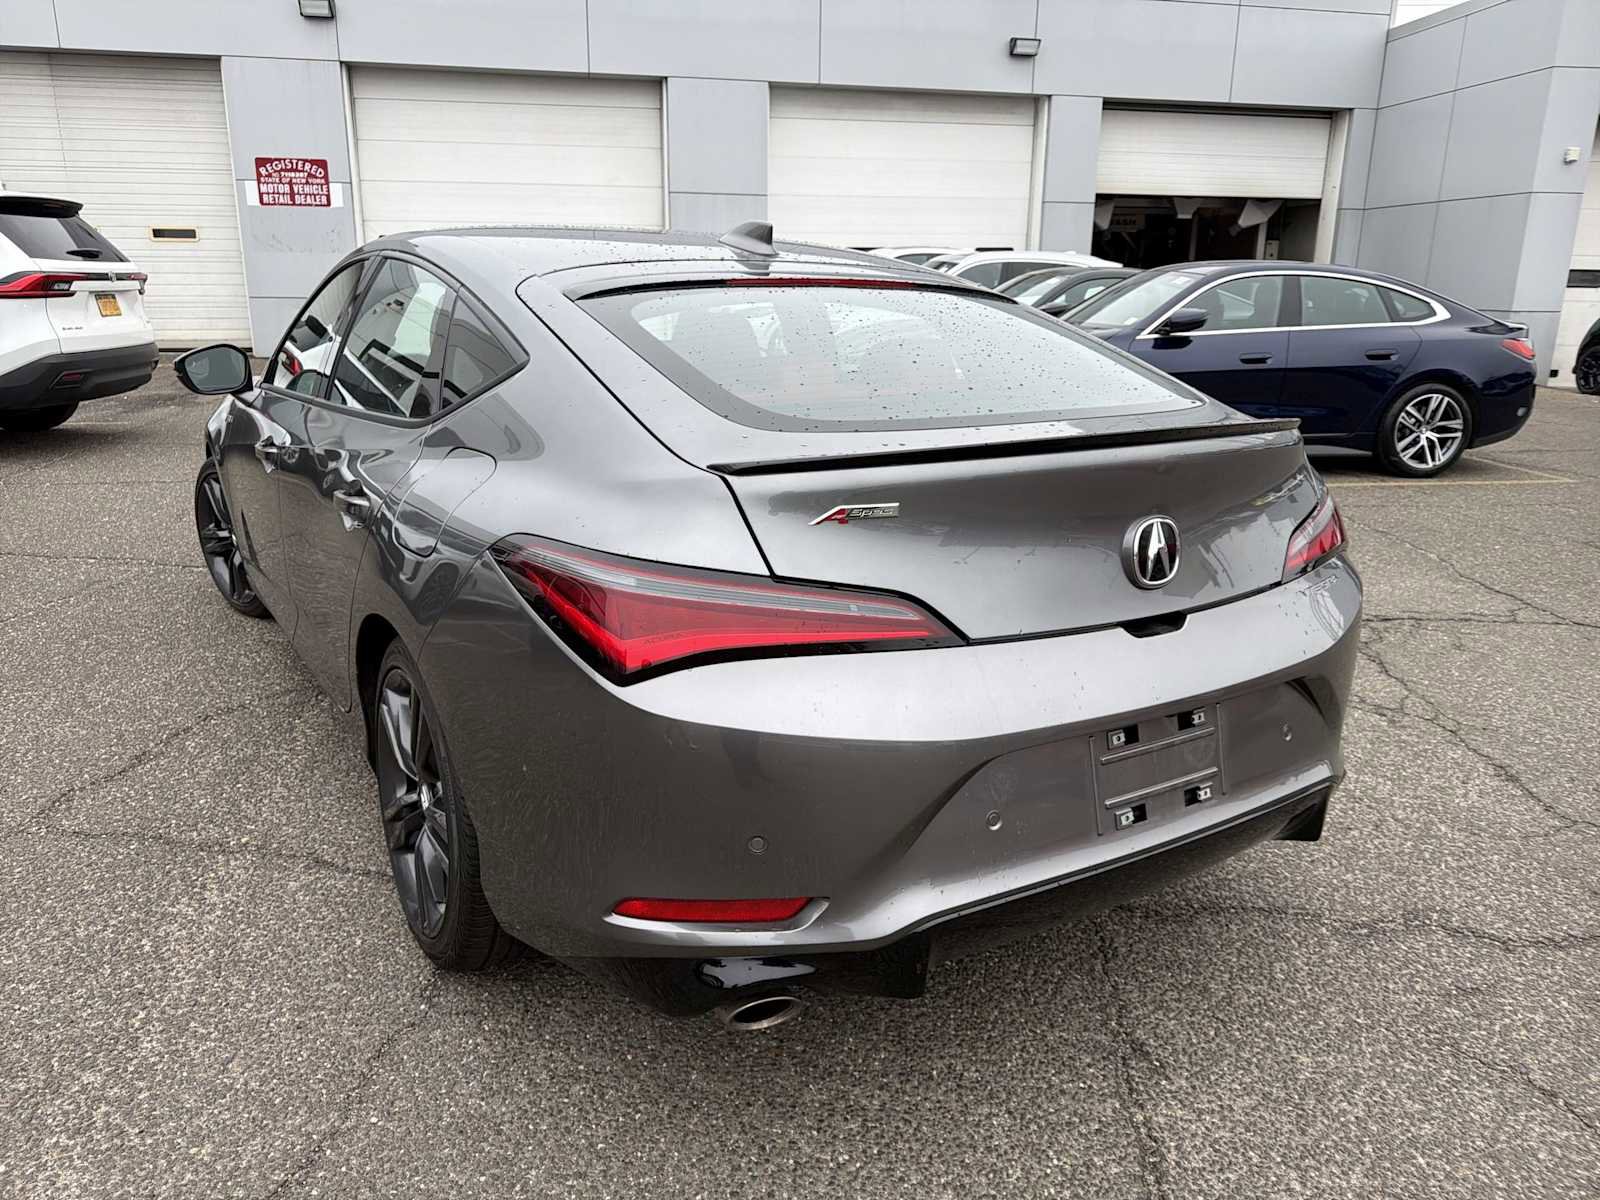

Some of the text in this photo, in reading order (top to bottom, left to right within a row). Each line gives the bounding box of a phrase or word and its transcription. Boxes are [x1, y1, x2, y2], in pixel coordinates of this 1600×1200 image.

[259, 159, 325, 178] REGISTERED
[259, 183, 329, 195] MOTOR VEHICLE
[262, 194, 328, 205] RETAIL DEALER
